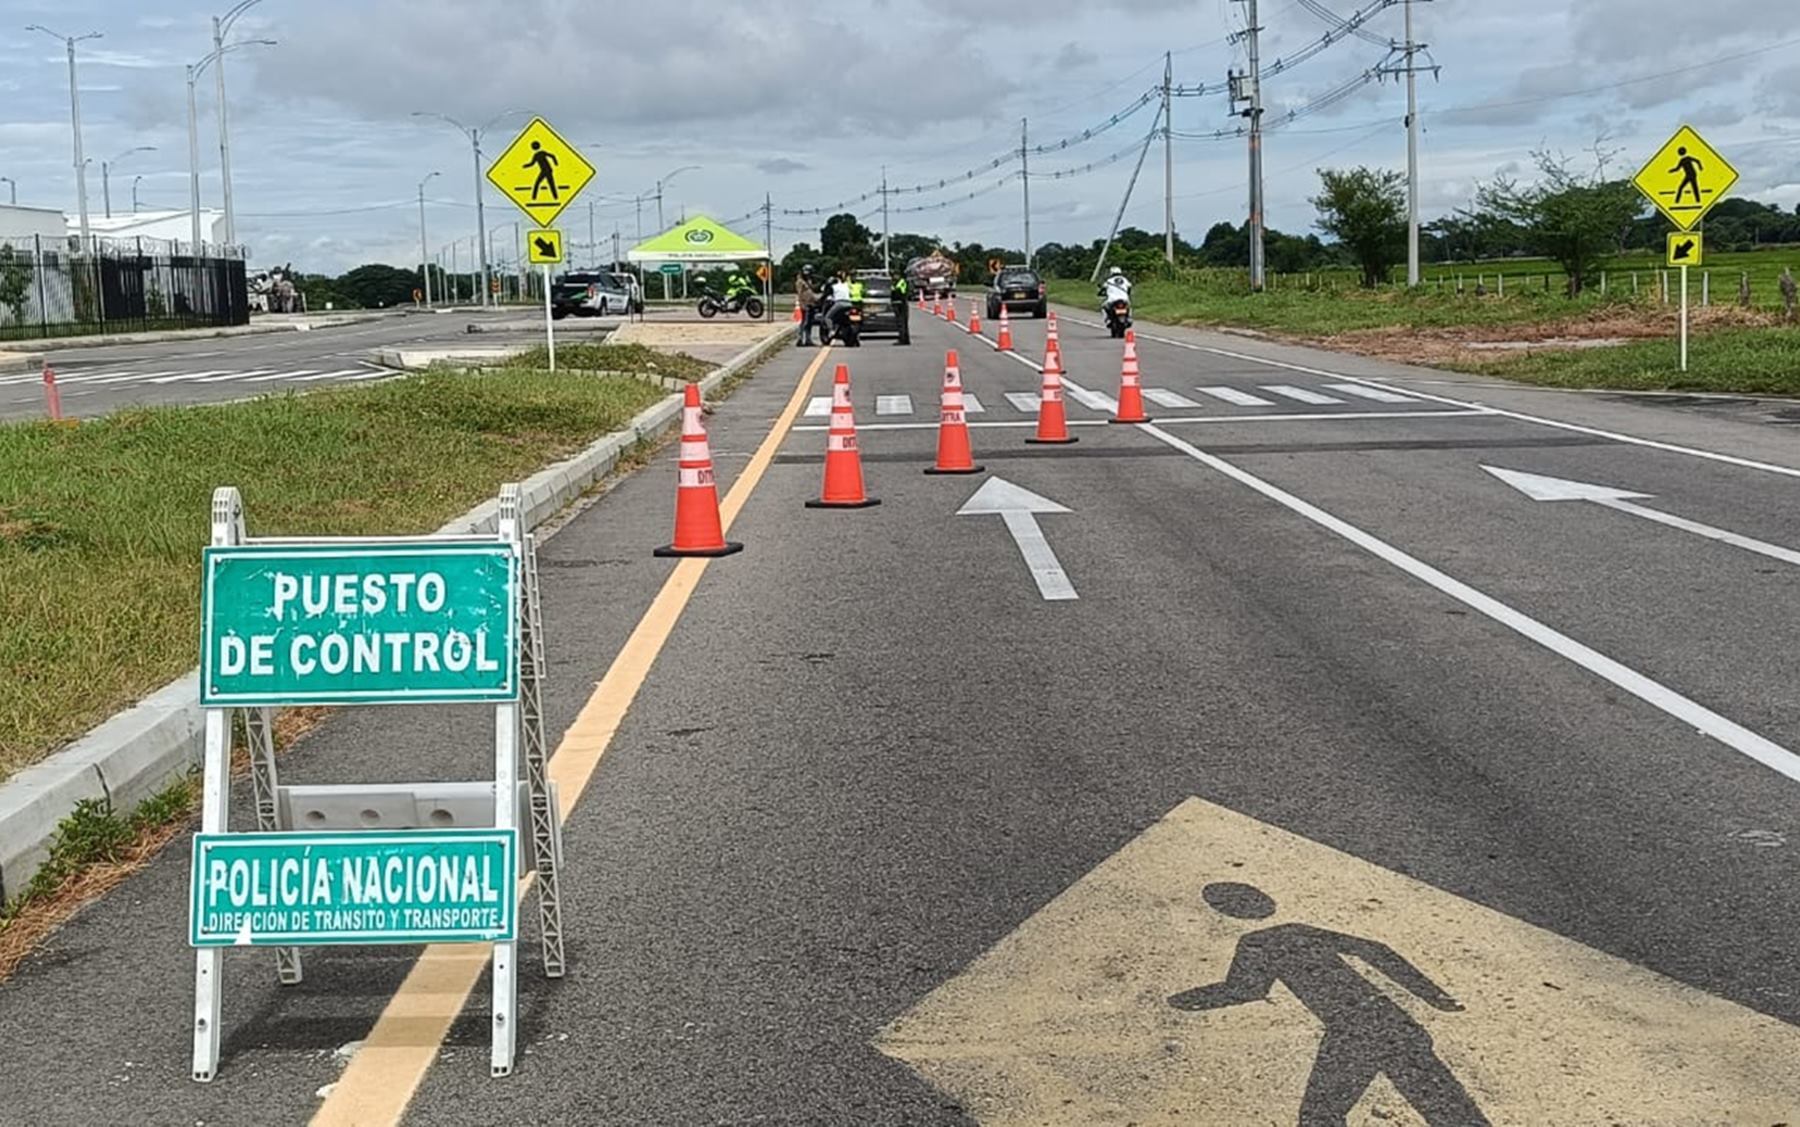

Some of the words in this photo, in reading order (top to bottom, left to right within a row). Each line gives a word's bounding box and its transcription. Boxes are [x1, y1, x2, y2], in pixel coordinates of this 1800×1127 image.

[273, 572, 446, 617] PUESTO
[220, 635, 274, 676] DE
[290, 631, 499, 675] CONTROL
[209, 846, 333, 907] POLICÍA
[342, 854, 498, 905] NACIONAL
[292, 911, 311, 931] DE
[390, 908, 400, 929] Y
[404, 907, 498, 929] TRANSPORTE
